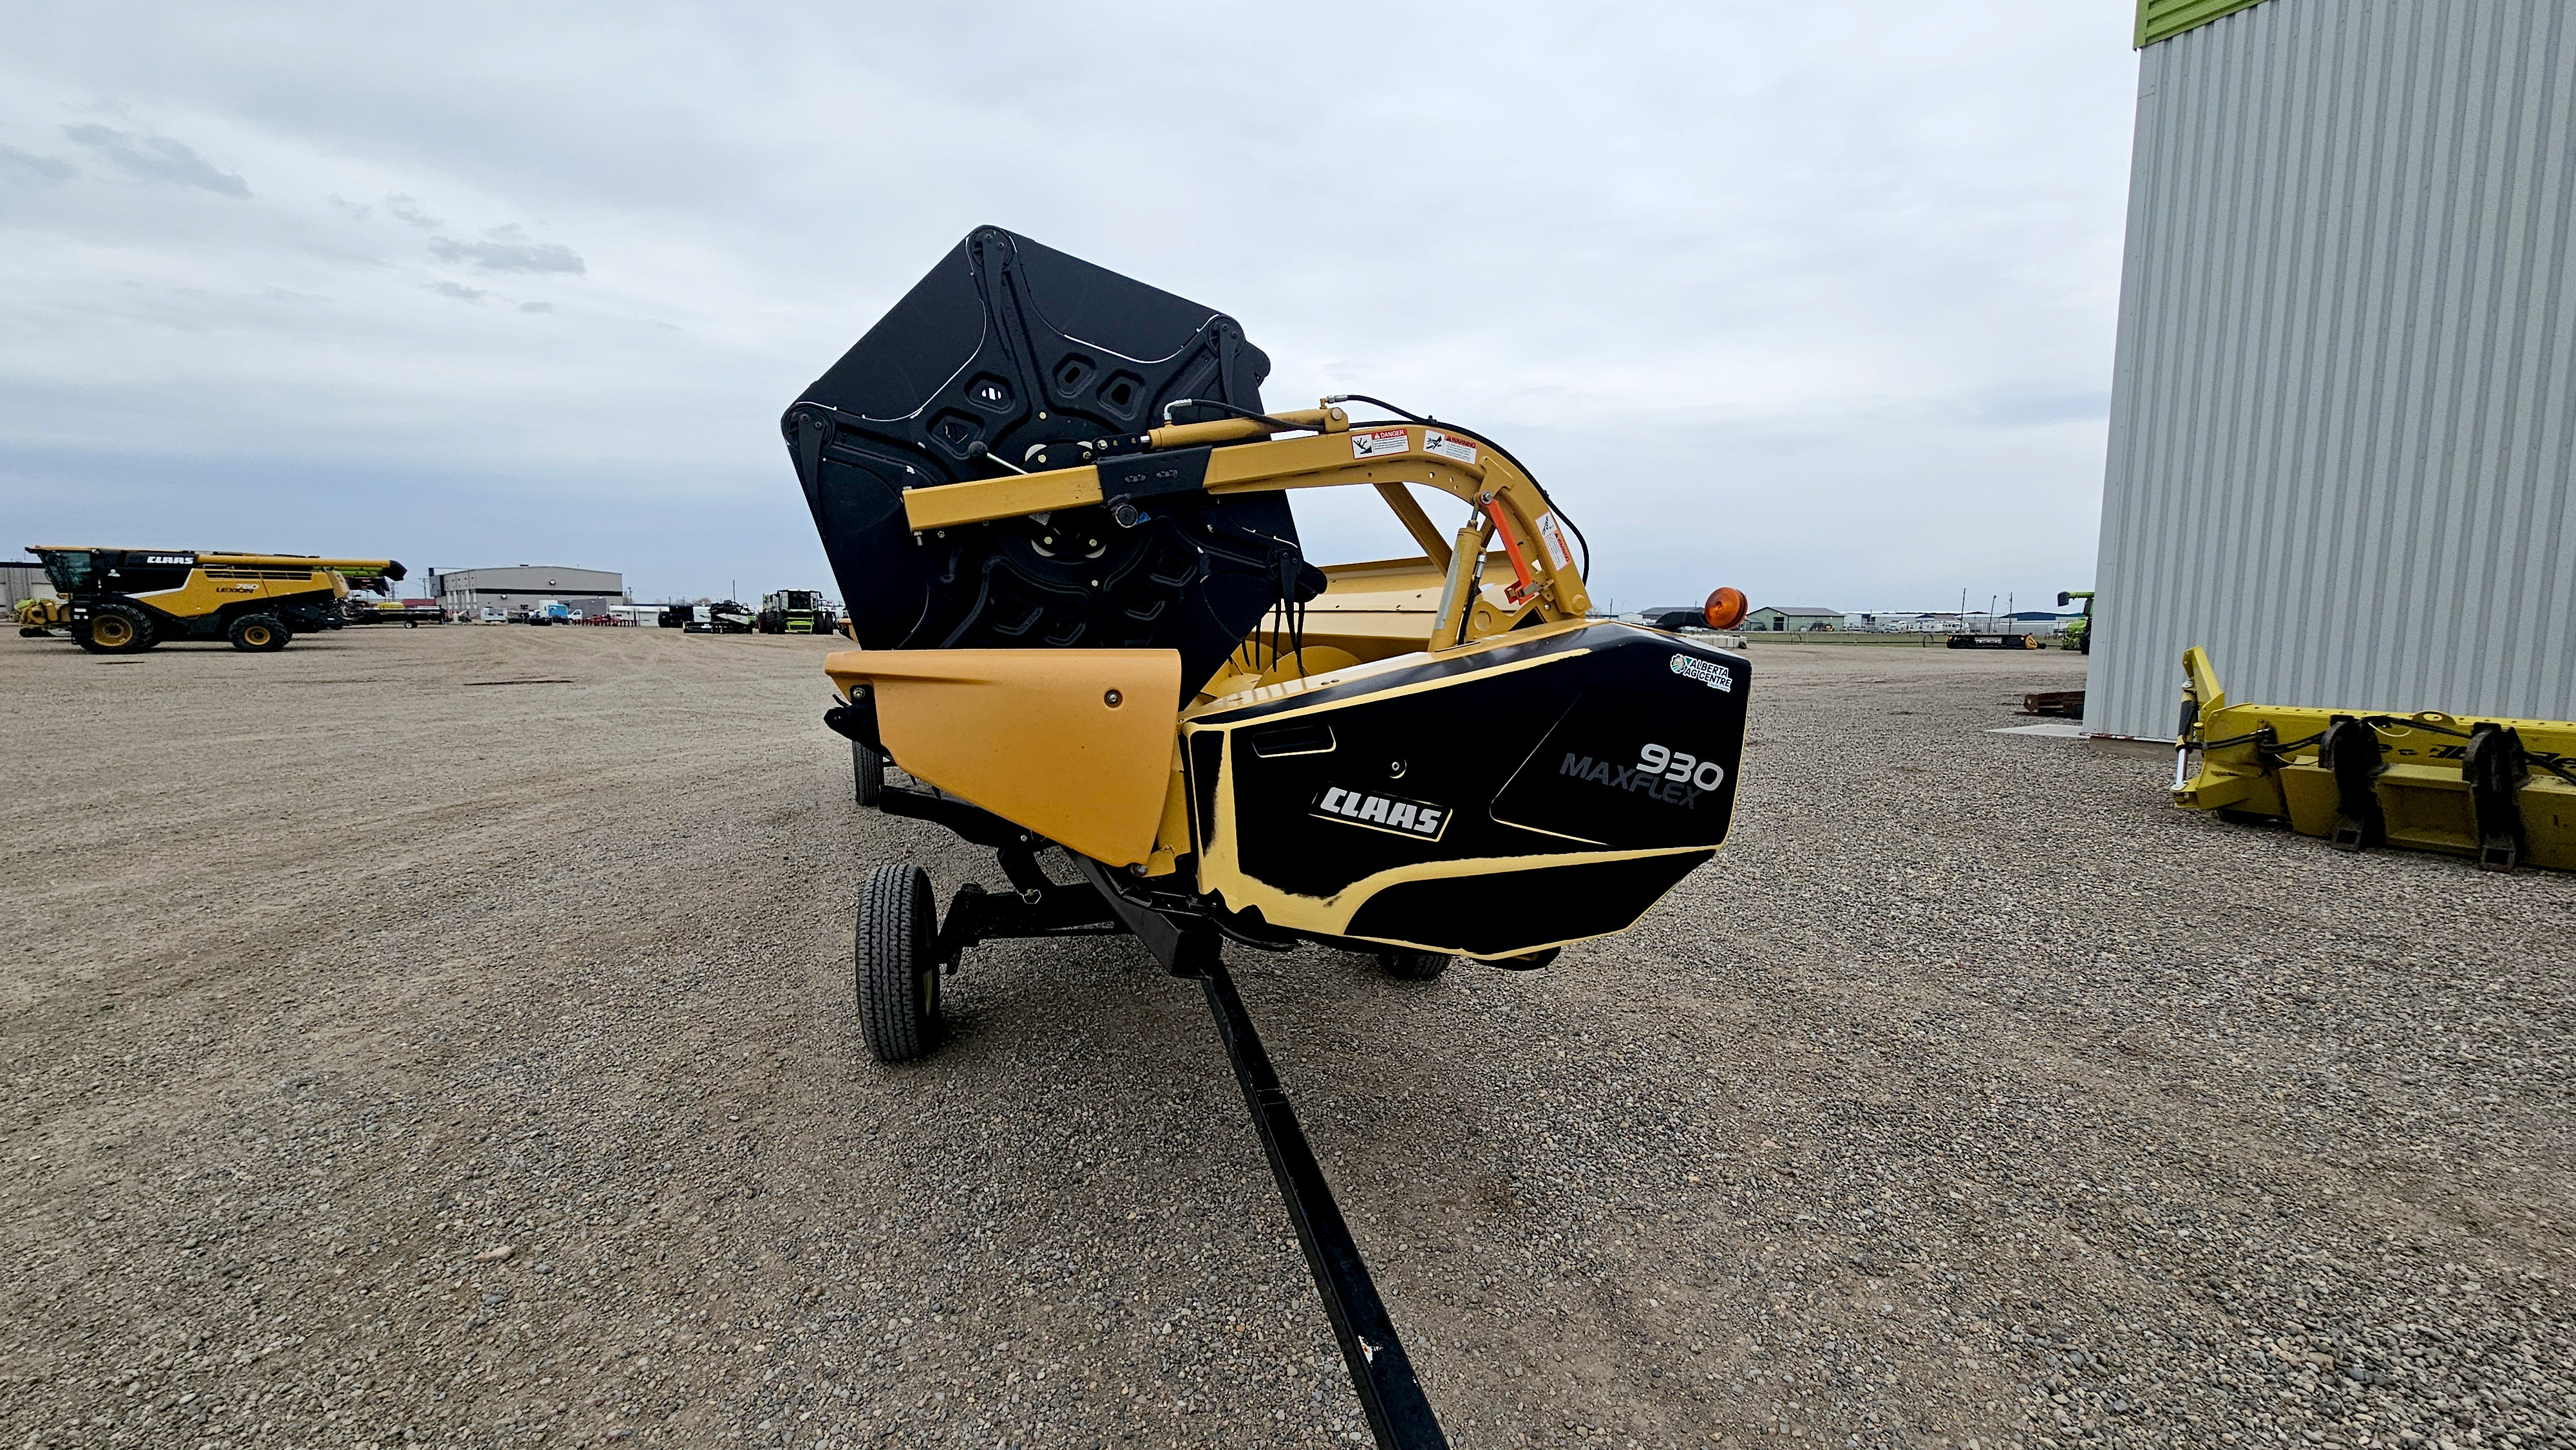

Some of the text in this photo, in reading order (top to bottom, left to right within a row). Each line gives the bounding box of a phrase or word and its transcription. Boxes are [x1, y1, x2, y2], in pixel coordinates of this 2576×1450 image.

[1380, 429, 1405, 438] DANGER
[1451, 437, 1476, 449] WARNING
[147, 556, 194, 565] CLAAS
[1684, 668, 1698, 677] AG
[1698, 672, 1731, 687] CENTRE
[1689, 659, 1728, 678] ALBERTA
[1636, 743, 1724, 791] 930
[1559, 753, 1703, 810] MAXFLEX
[1320, 787, 1442, 834] CLAAS
